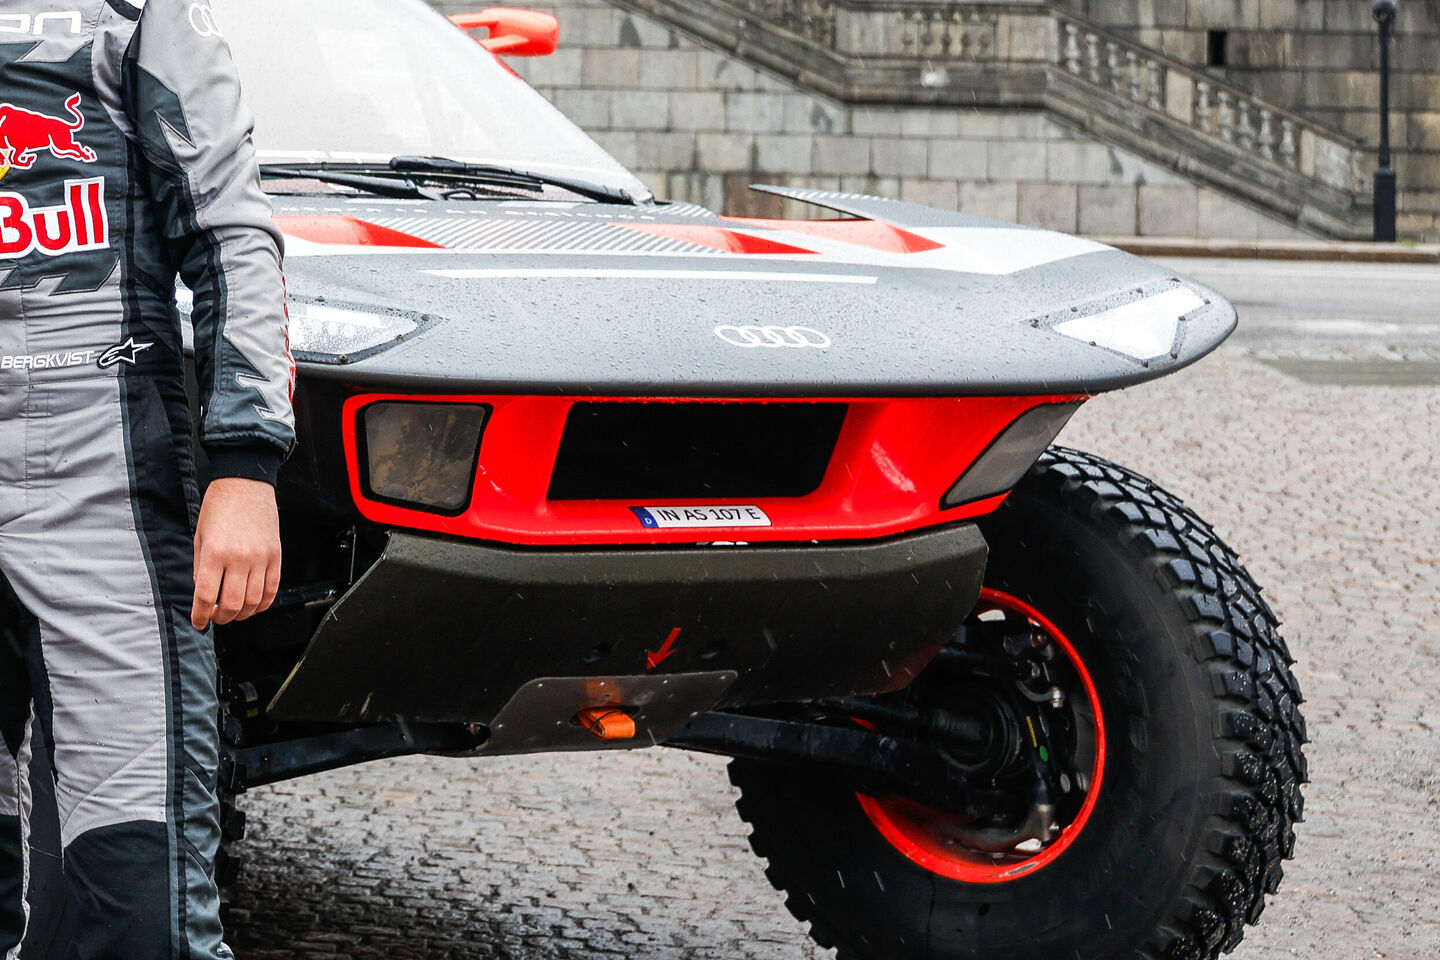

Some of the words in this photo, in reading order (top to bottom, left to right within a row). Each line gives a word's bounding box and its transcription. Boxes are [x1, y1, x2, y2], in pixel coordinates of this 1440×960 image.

[0, 350, 95, 370] BERGKVIST
[656, 509, 681, 521] IN
[683, 509, 708, 521] AS
[708, 508, 741, 520] 107
[744, 508, 761, 520] E
